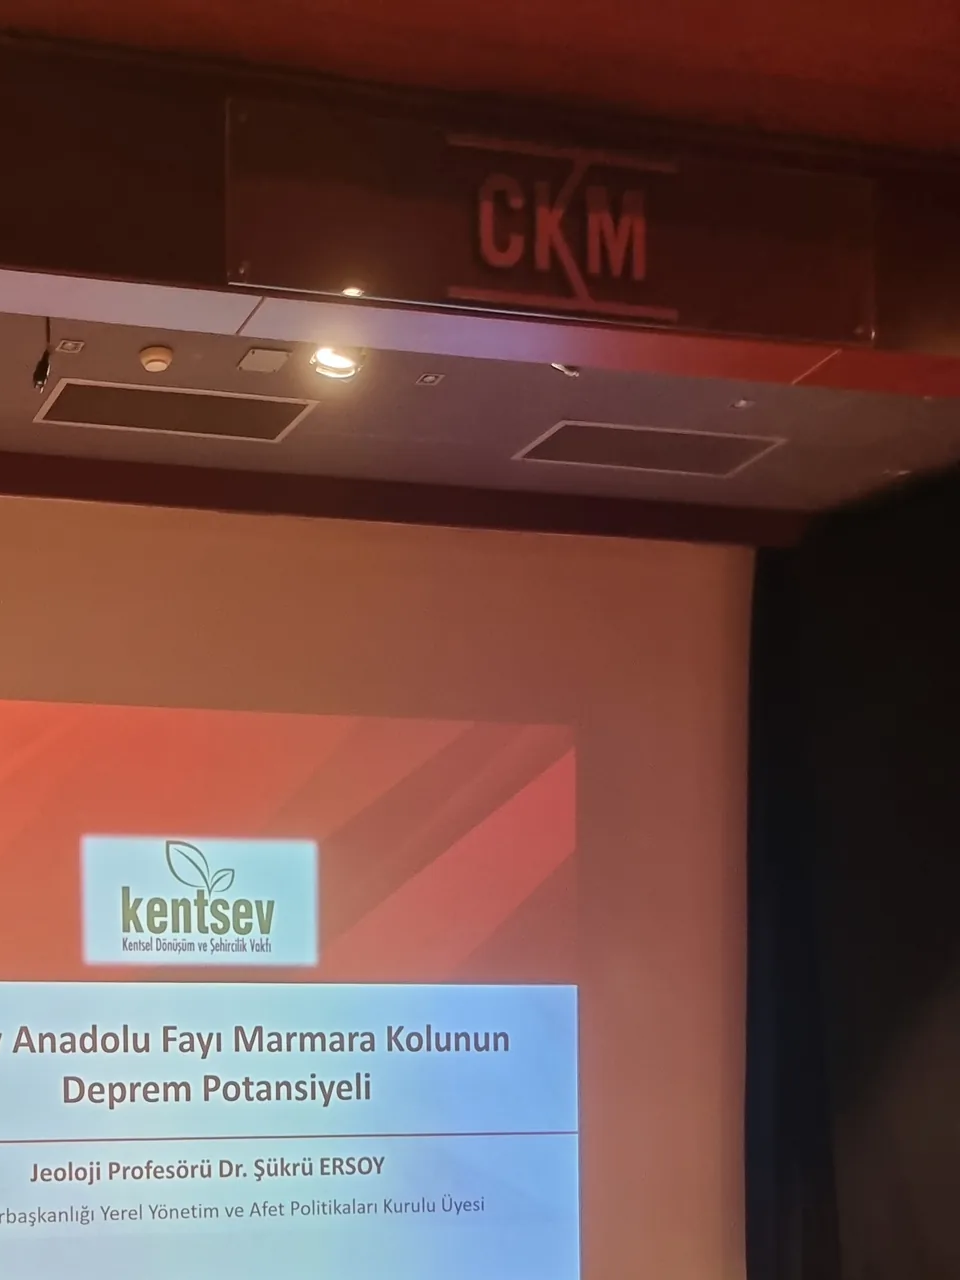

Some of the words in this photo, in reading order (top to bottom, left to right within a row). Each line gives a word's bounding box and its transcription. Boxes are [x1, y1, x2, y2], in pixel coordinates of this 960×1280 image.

[479, 160, 646, 299] CKM
[121, 886, 275, 935] kentsev
[122, 937, 153, 952] Kentsel
[156, 938, 195, 955] Dönüşüm
[198, 942, 208, 952] ve
[210, 937, 247, 955] Şehircilik
[249, 938, 272, 953] Vakfı
[12, 1024, 150, 1053] Anadolu
[162, 1025, 222, 1059] Fayı
[234, 1025, 375, 1052] Marmara
[386, 1024, 510, 1052] Kolunun
[63, 1075, 191, 1110] Deprem
[203, 1072, 371, 1107] Potansiyeli
[30, 1161, 101, 1185] Jeoloji
[108, 1159, 212, 1180] Profesörü
[219, 1159, 247, 1178] Dr.
[254, 1157, 313, 1181] Şükrü
[320, 1156, 385, 1176] ERSOY
[100, 1204, 143, 1221] Yerel
[148, 1202, 219, 1219] Yönetim
[225, 1206, 244, 1218] ve
[249, 1200, 284, 1217] Afet
[290, 1198, 378, 1217] Politikaları
[383, 1196, 436, 1213] Kurulu
[441, 1195, 485, 1215] Üyesi
